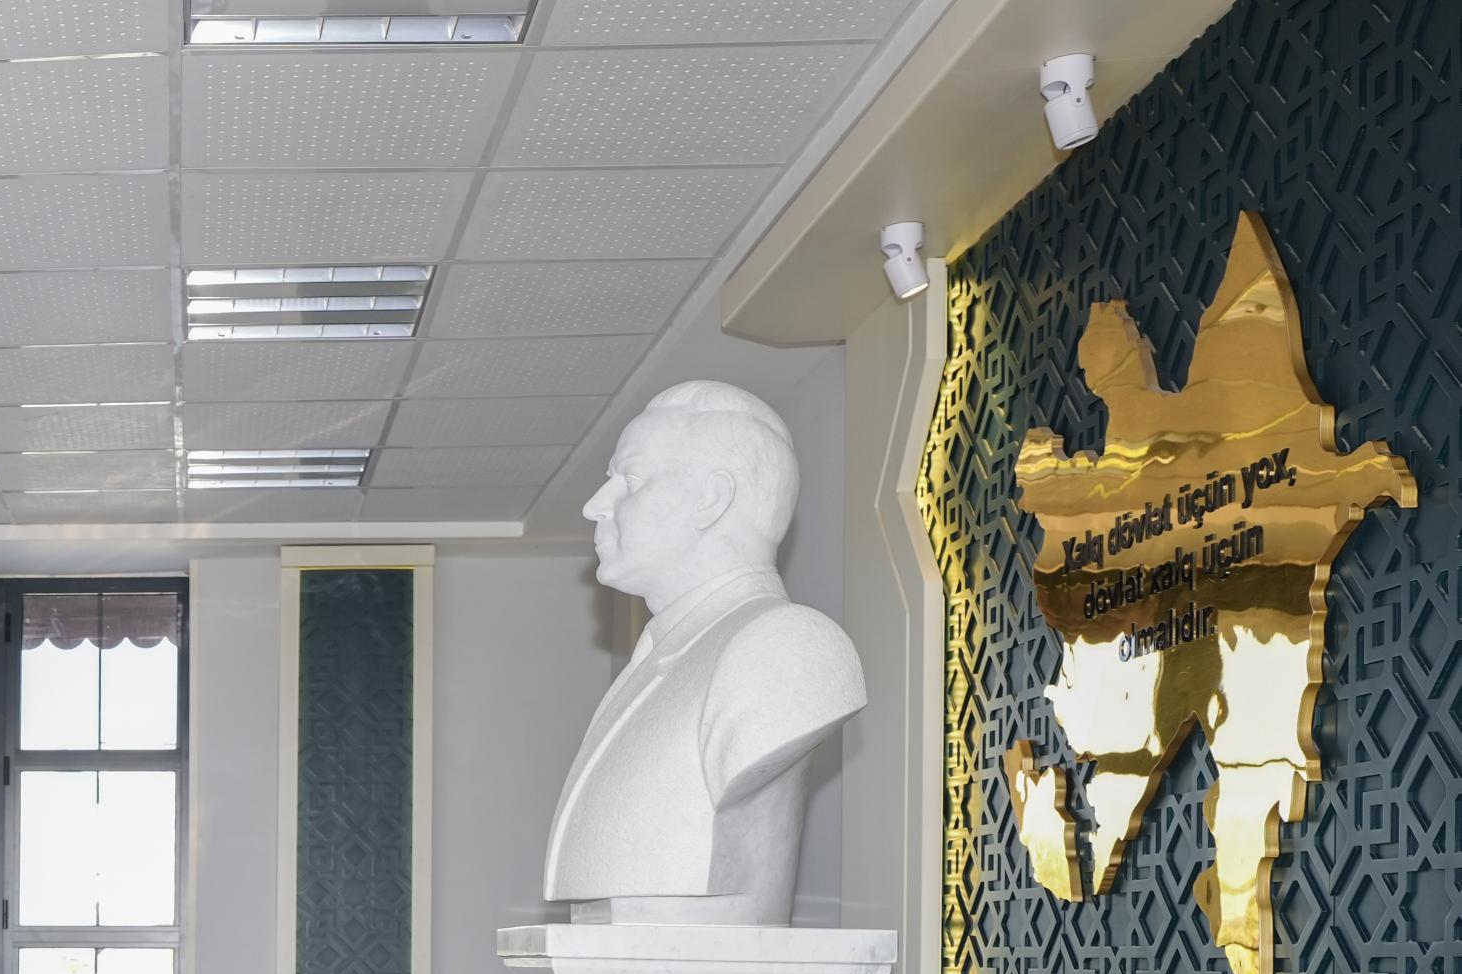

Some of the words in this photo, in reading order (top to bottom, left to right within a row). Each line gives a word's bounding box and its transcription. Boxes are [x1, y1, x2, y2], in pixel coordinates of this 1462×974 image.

[1061, 529, 1104, 575] Xalq
[1107, 493, 1173, 556] dövlət
[1178, 470, 1235, 529] üçün
[1241, 448, 1297, 509] yox,
[1083, 563, 1145, 619] dövlət
[1149, 546, 1197, 591] xalq
[1202, 520, 1264, 579] üçün
